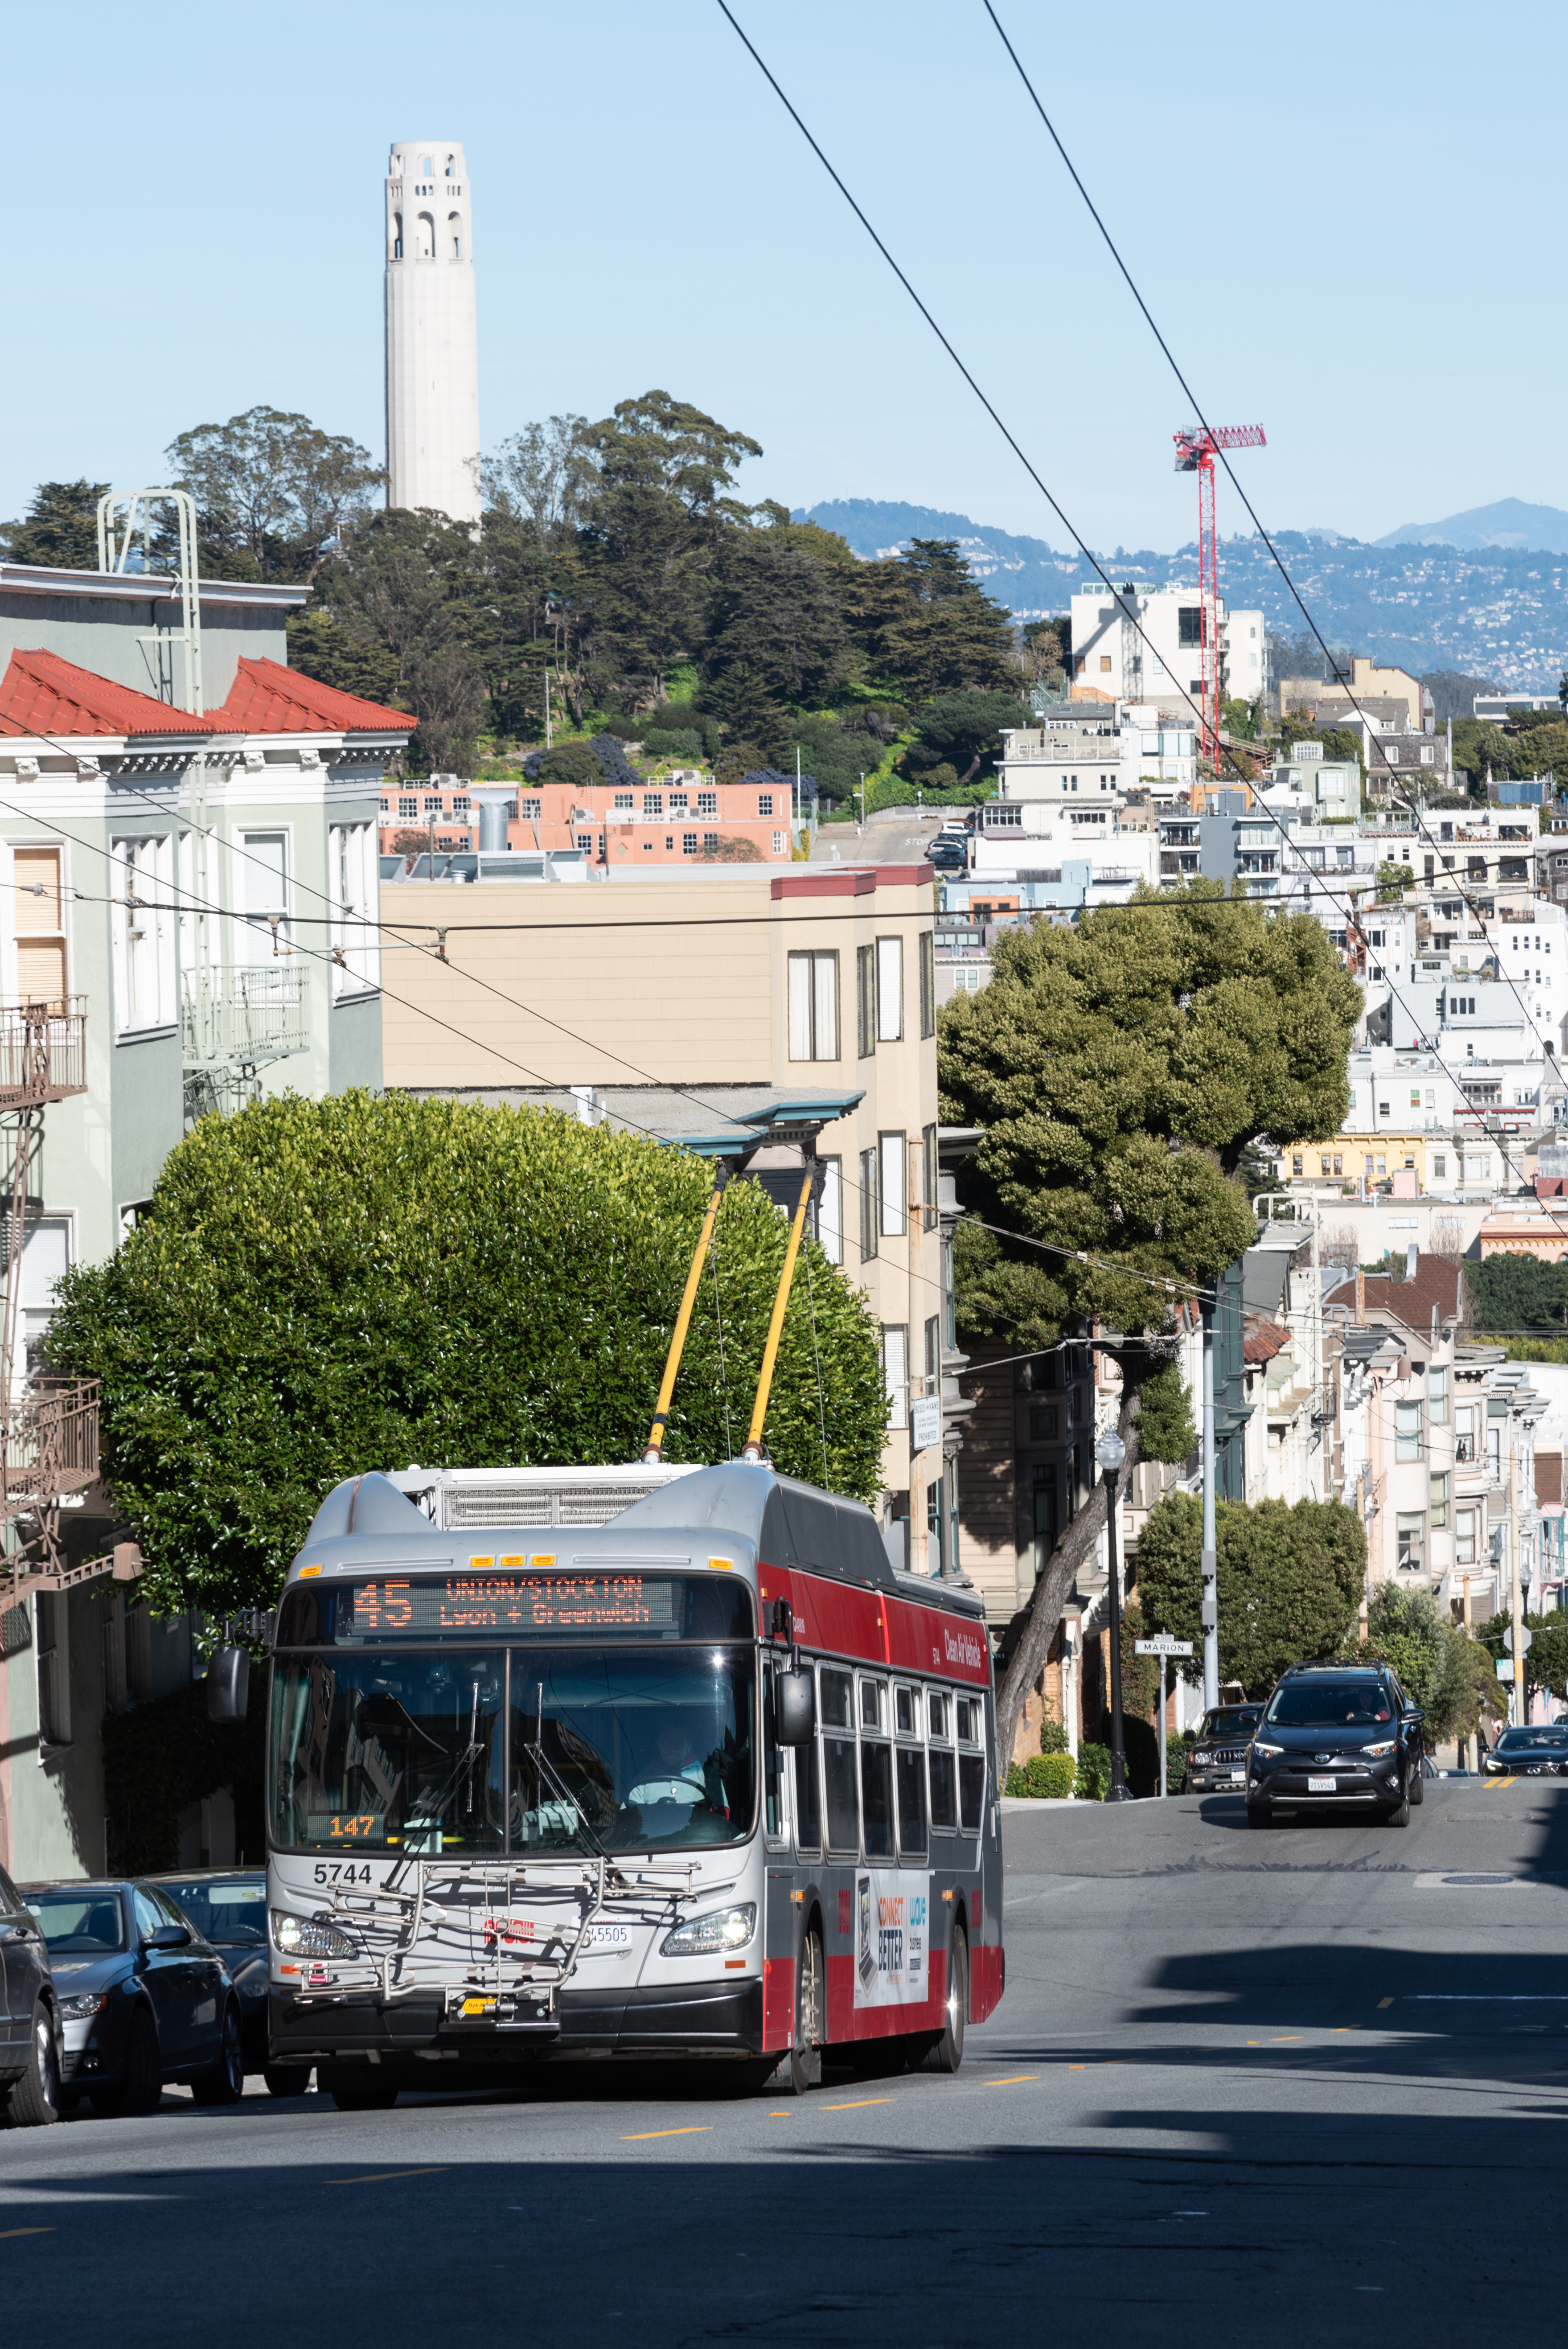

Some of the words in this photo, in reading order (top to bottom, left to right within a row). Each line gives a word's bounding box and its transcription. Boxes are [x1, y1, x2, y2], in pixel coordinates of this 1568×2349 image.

[904, 838, 930, 846] STOP
[915, 1404, 925, 1414] BUSES
[929, 1401, 939, 1411] VANS
[919, 1430, 936, 1442] PROHIBITED
[446, 1575, 642, 1600] UNION/STOCKTON
[354, 1580, 412, 1626] 45
[441, 1606, 497, 1625] Lyon
[533, 1601, 649, 1623] Greenwich
[932, 1647, 940, 1665] 5744
[944, 1628, 958, 1663] Clean
[963, 1634, 981, 1668] Vehicle
[1144, 1643, 1184, 1651] MARION
[331, 1816, 374, 1836] 147
[314, 1864, 372, 1885] 5744
[879, 1897, 903, 1926] CONNECT
[910, 1896, 926, 1926] wave
[878, 1929, 903, 1971] BETTER
